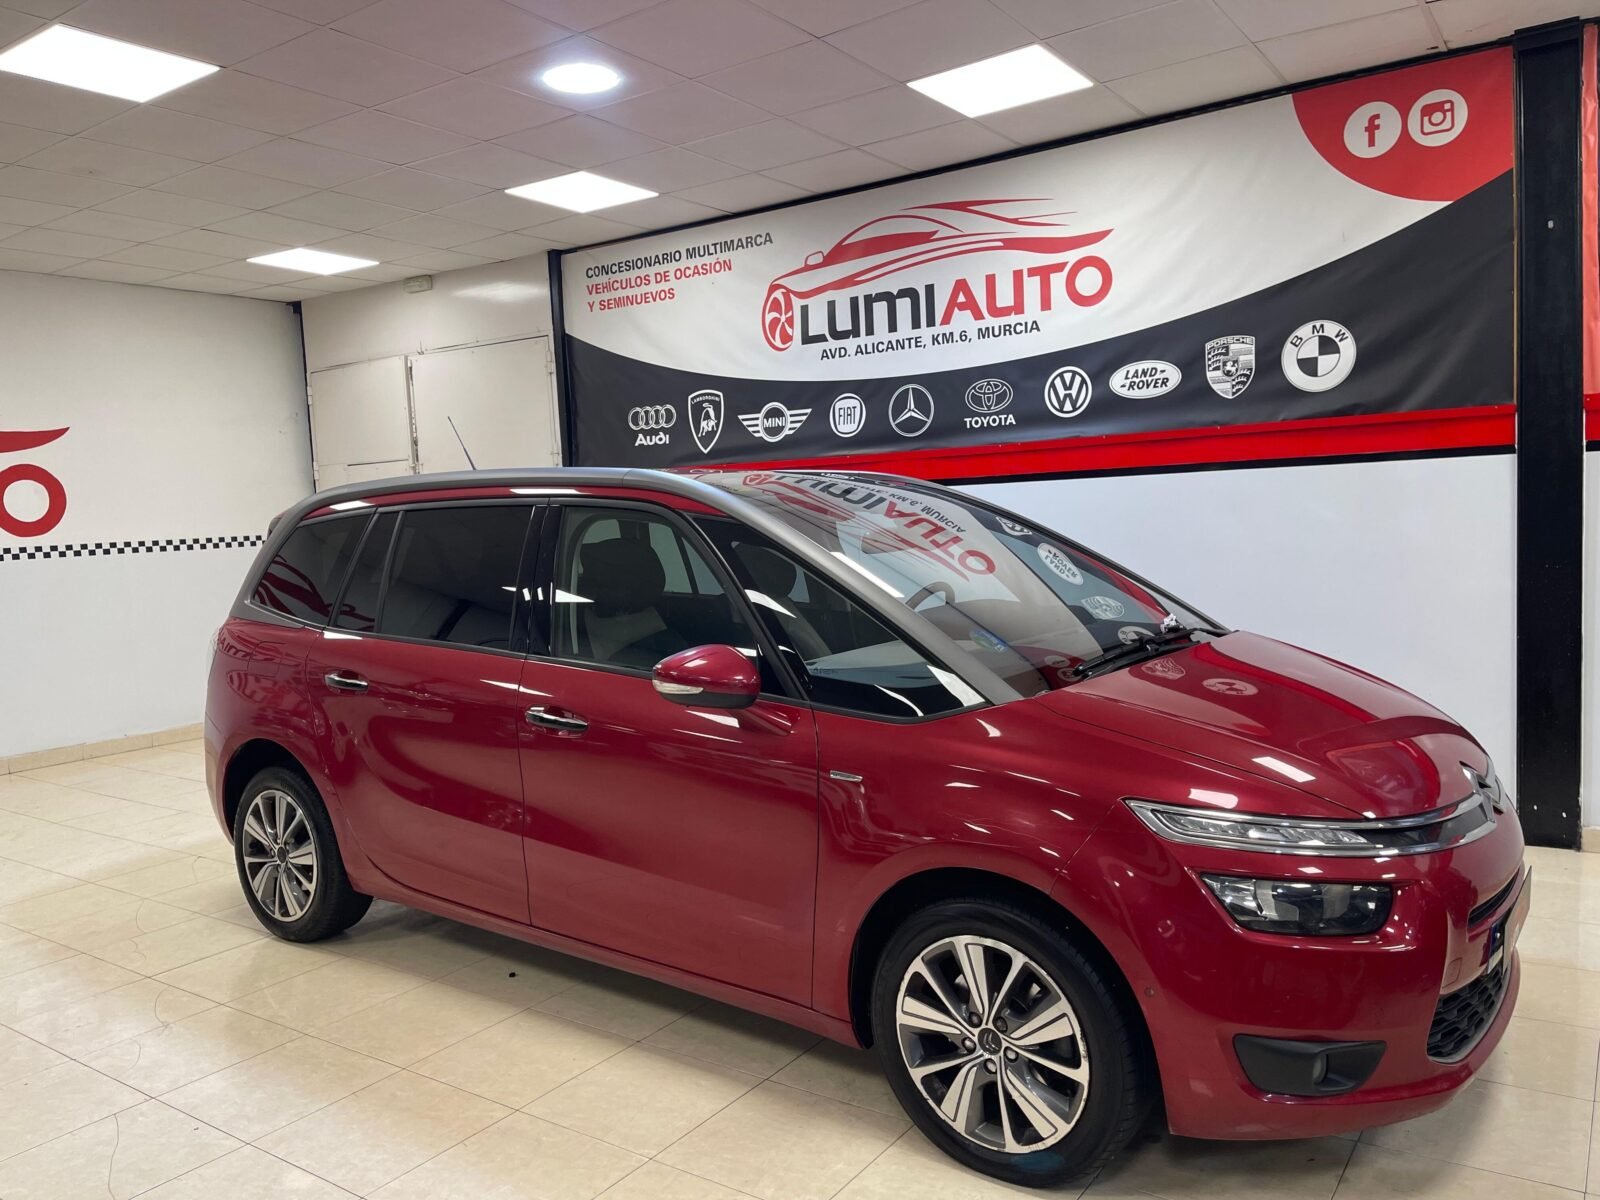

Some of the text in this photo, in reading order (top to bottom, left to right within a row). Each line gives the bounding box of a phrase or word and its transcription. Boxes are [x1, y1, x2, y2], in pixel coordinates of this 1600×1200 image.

[585, 232, 774, 279] CONCESIONARIO MULTIMARCA
[586, 258, 733, 296] VEHÍCULOS DE OCASIÓN
[587, 287, 676, 313] Y SEMINUEVOS
[820, 319, 1041, 361] AVD. ALICANTE, KM.6, MURCIA
[1207, 336, 1254, 350] PORSCHE
[1290, 323, 1349, 348] BMW
[763, 416, 787, 429] MINI
[837, 405, 857, 426] FIAT
[964, 414, 1017, 430] TOYOTA
[634, 431, 670, 447] Audi
